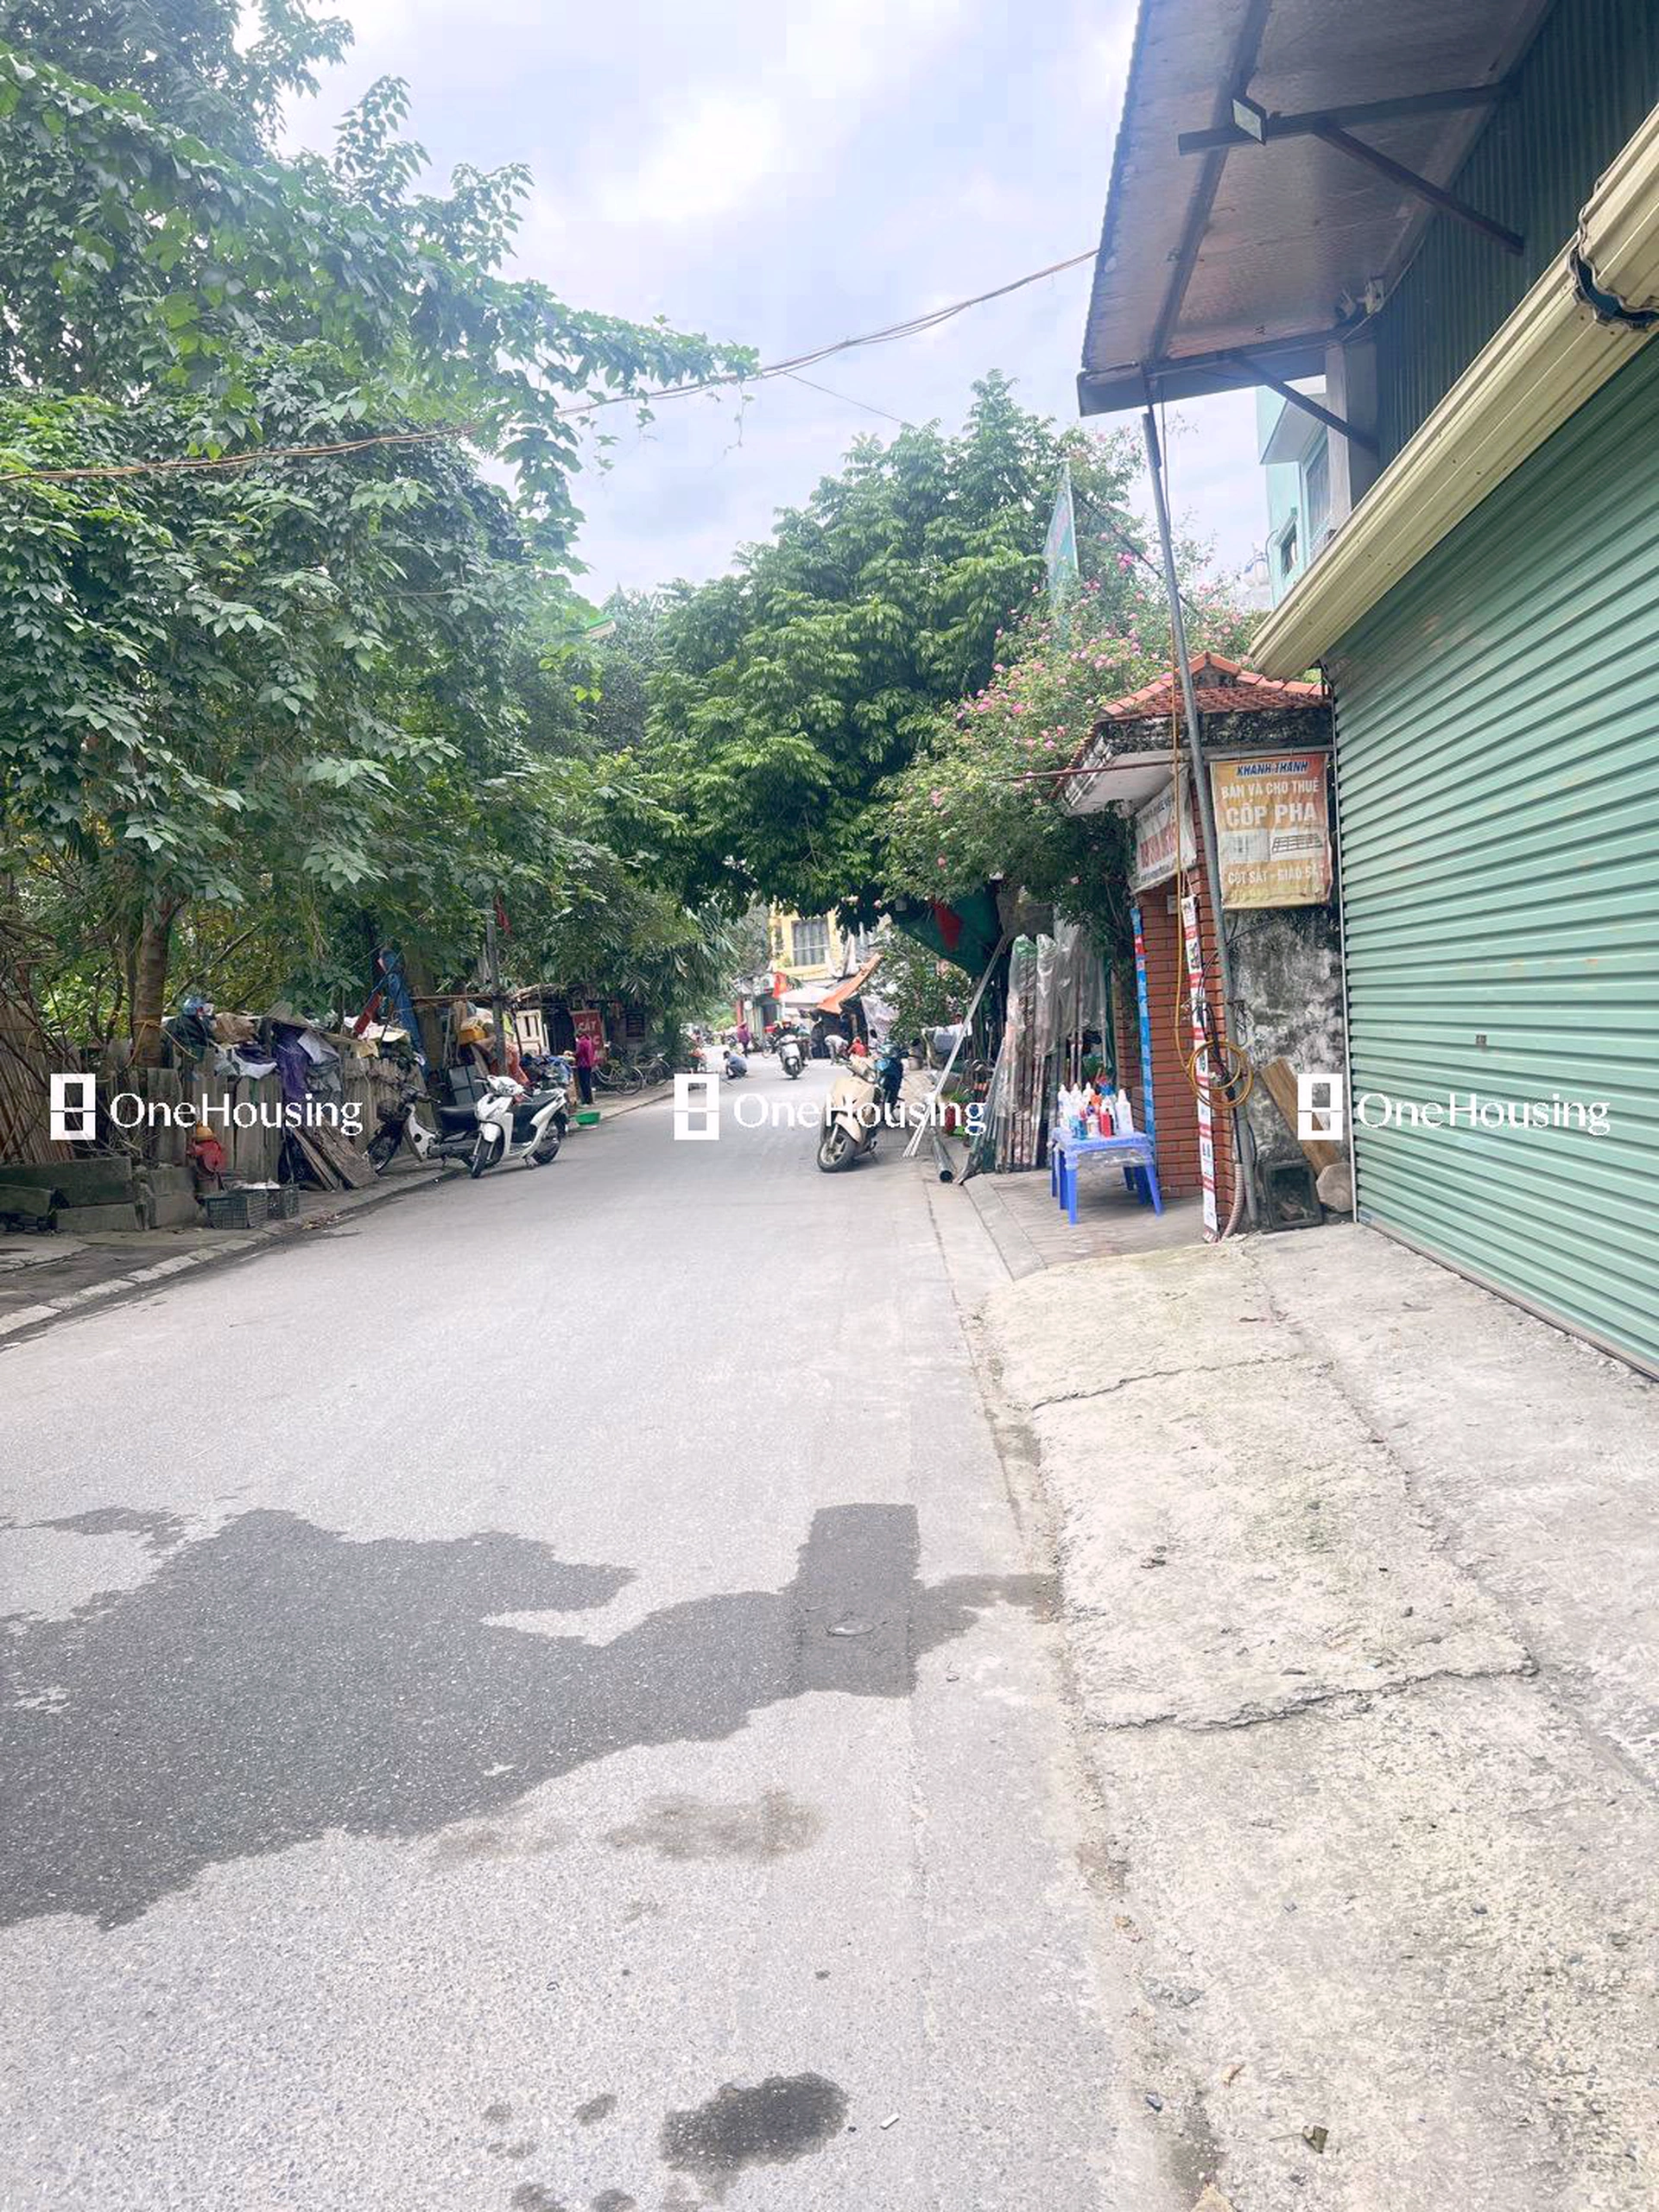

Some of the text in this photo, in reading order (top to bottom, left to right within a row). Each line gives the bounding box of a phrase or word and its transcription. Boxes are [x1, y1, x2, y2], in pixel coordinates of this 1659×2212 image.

[1266, 780, 1289, 795] CHO
[1226, 799, 1317, 827] CỐP PHA
